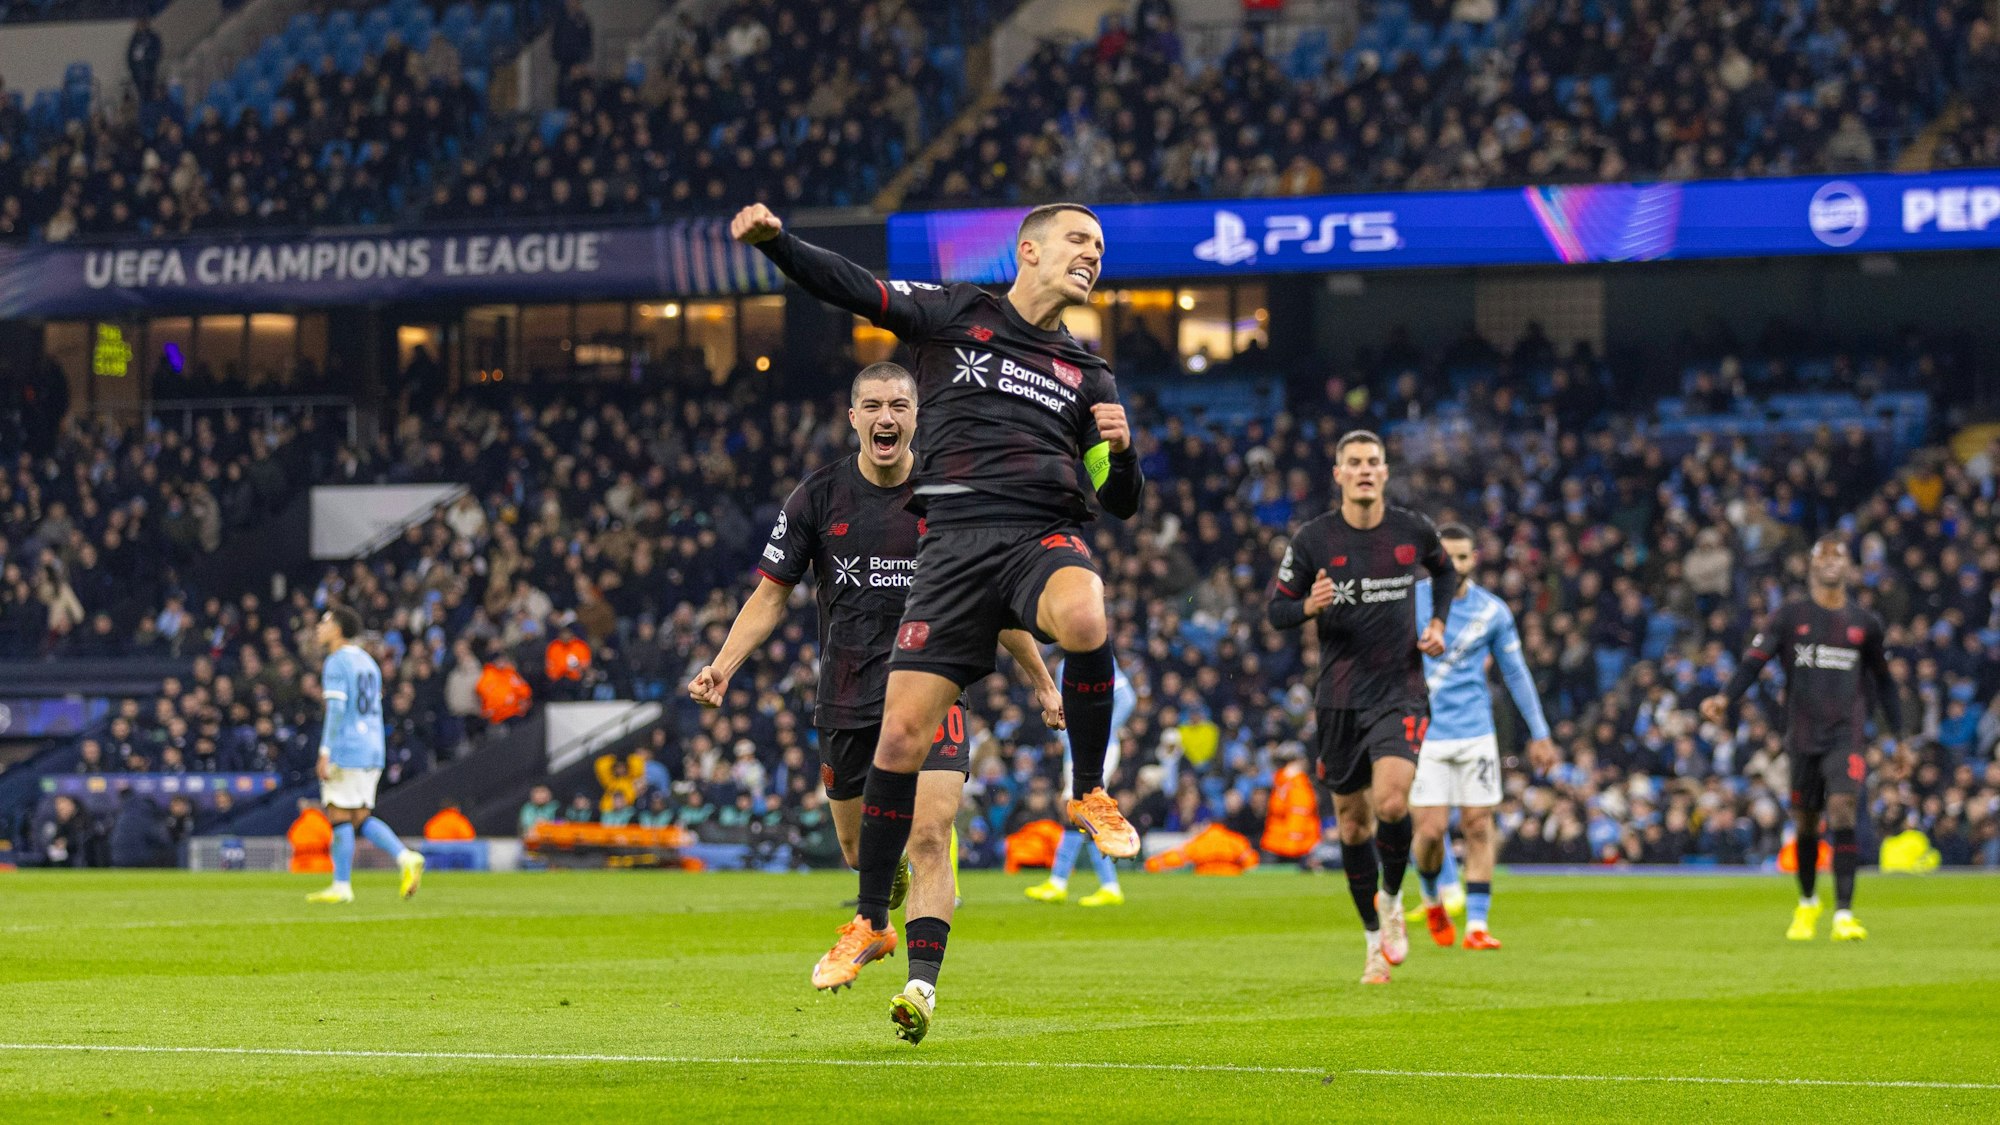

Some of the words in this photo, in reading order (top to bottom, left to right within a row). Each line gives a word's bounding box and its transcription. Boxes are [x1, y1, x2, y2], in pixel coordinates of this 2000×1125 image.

[1264, 211, 1398, 255] PS5
[85, 249, 187, 289] UEFA
[196, 238, 432, 286] CHAMPIONS
[442, 231, 600, 276] LEAGUE
[998, 378, 1066, 413] Gothaer
